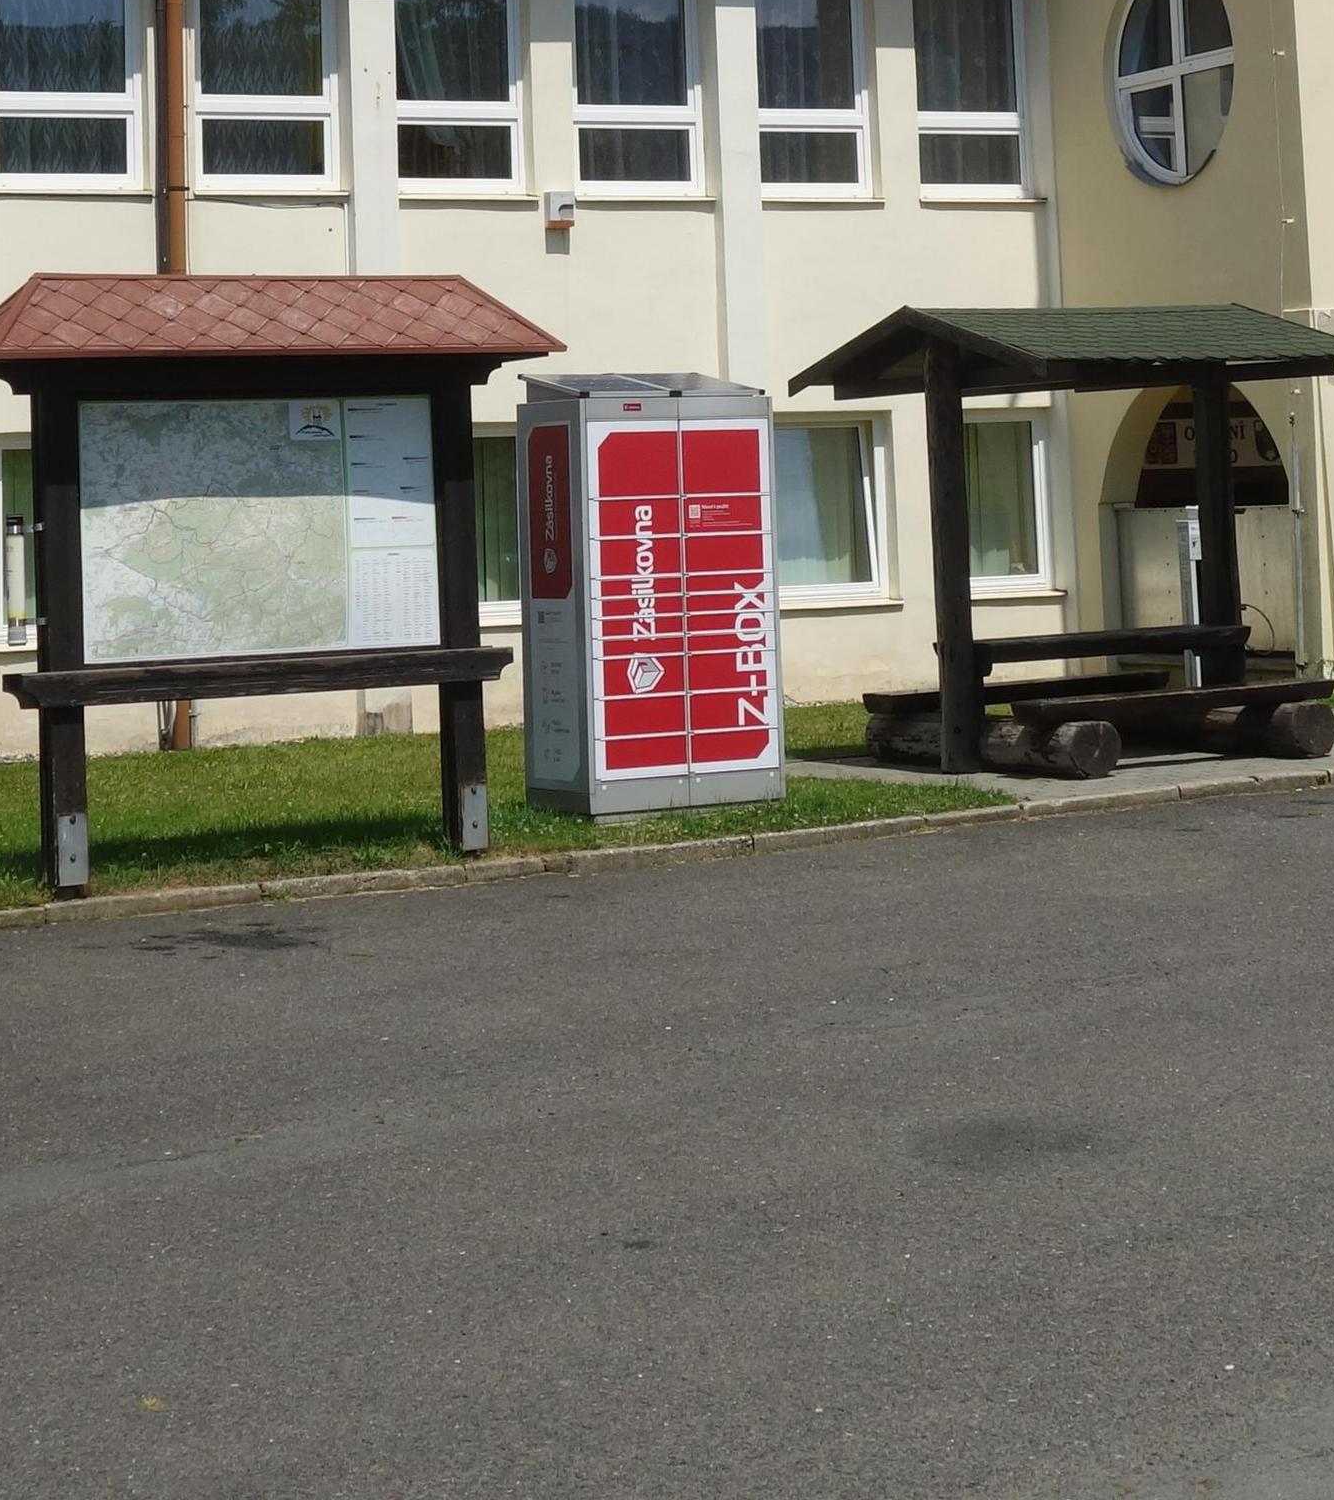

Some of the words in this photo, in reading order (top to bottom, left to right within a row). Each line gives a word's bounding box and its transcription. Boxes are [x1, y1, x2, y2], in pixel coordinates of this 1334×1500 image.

[545, 455, 555, 541] Zásilkovna
[631, 504, 656, 641] Zásilkovna
[734, 579, 770, 726] Z-BOX
